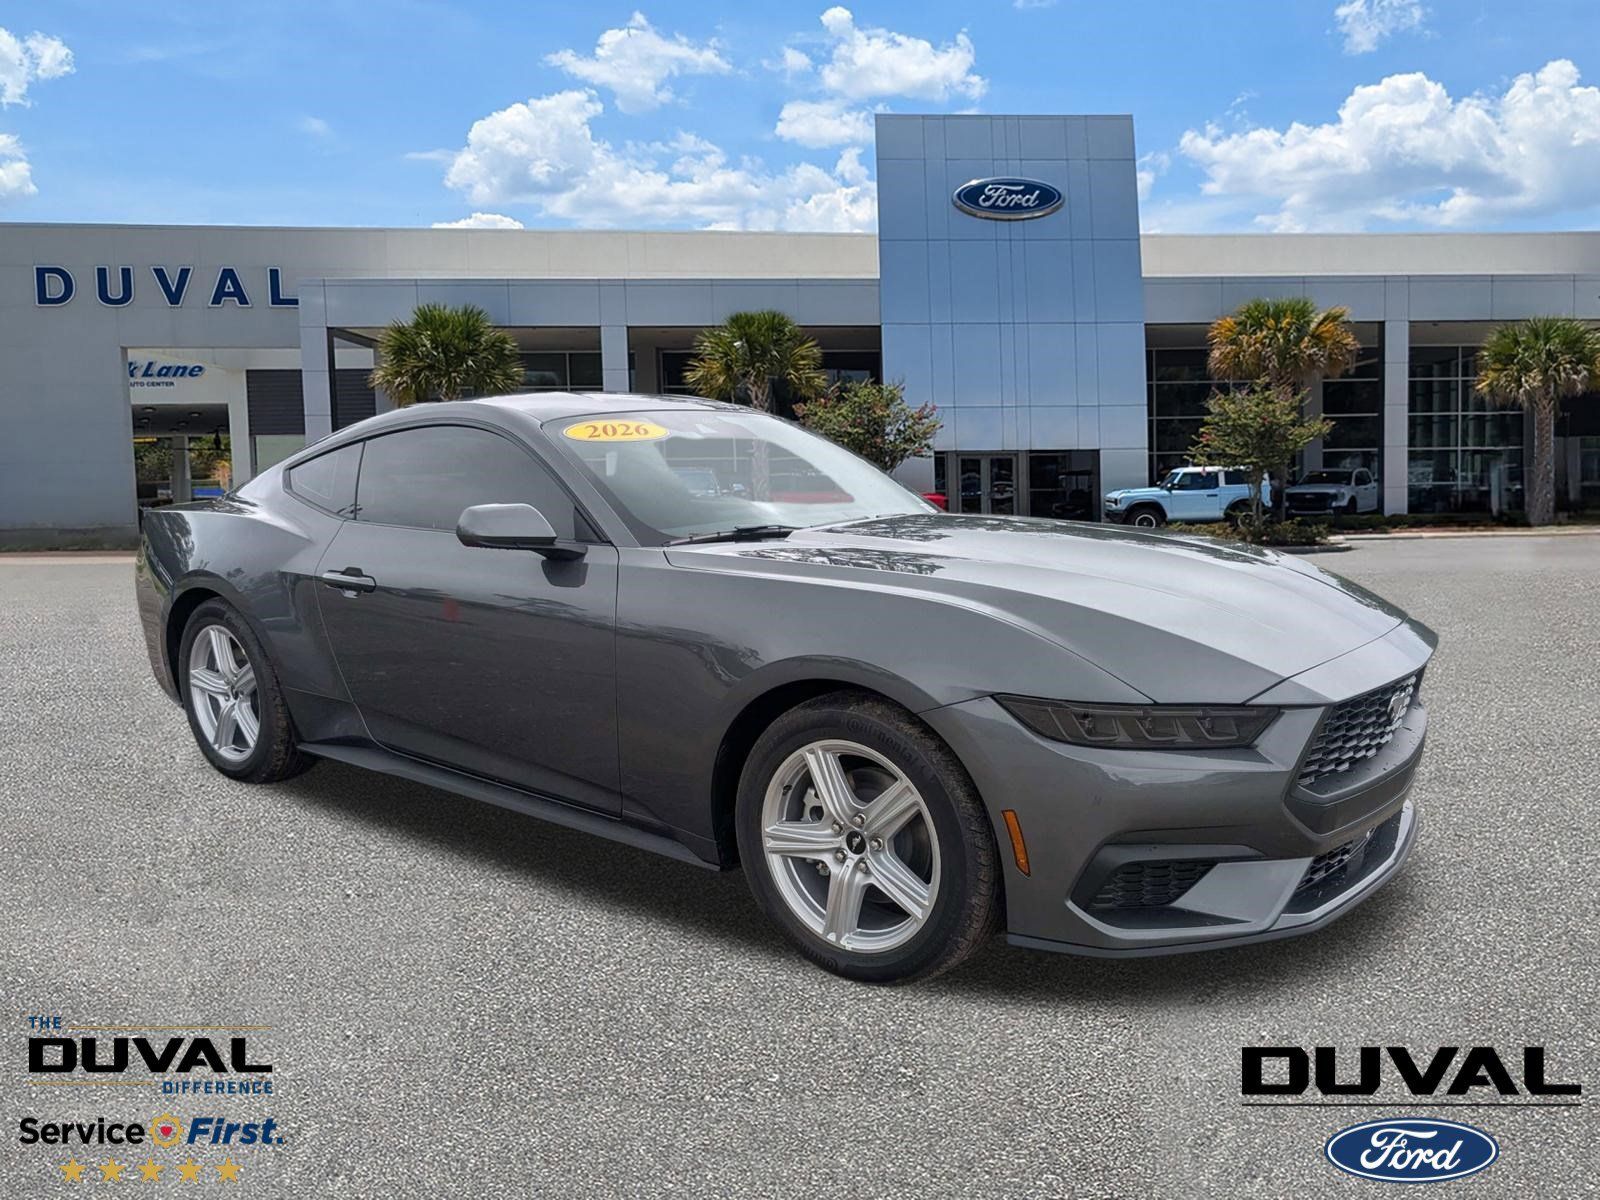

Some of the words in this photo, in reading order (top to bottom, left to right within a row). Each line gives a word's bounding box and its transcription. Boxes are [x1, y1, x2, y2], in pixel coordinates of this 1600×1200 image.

[979, 184, 1040, 207] Ford
[34, 265, 299, 308] DUVAL
[142, 361, 205, 377] Lane
[585, 423, 649, 438] 2026
